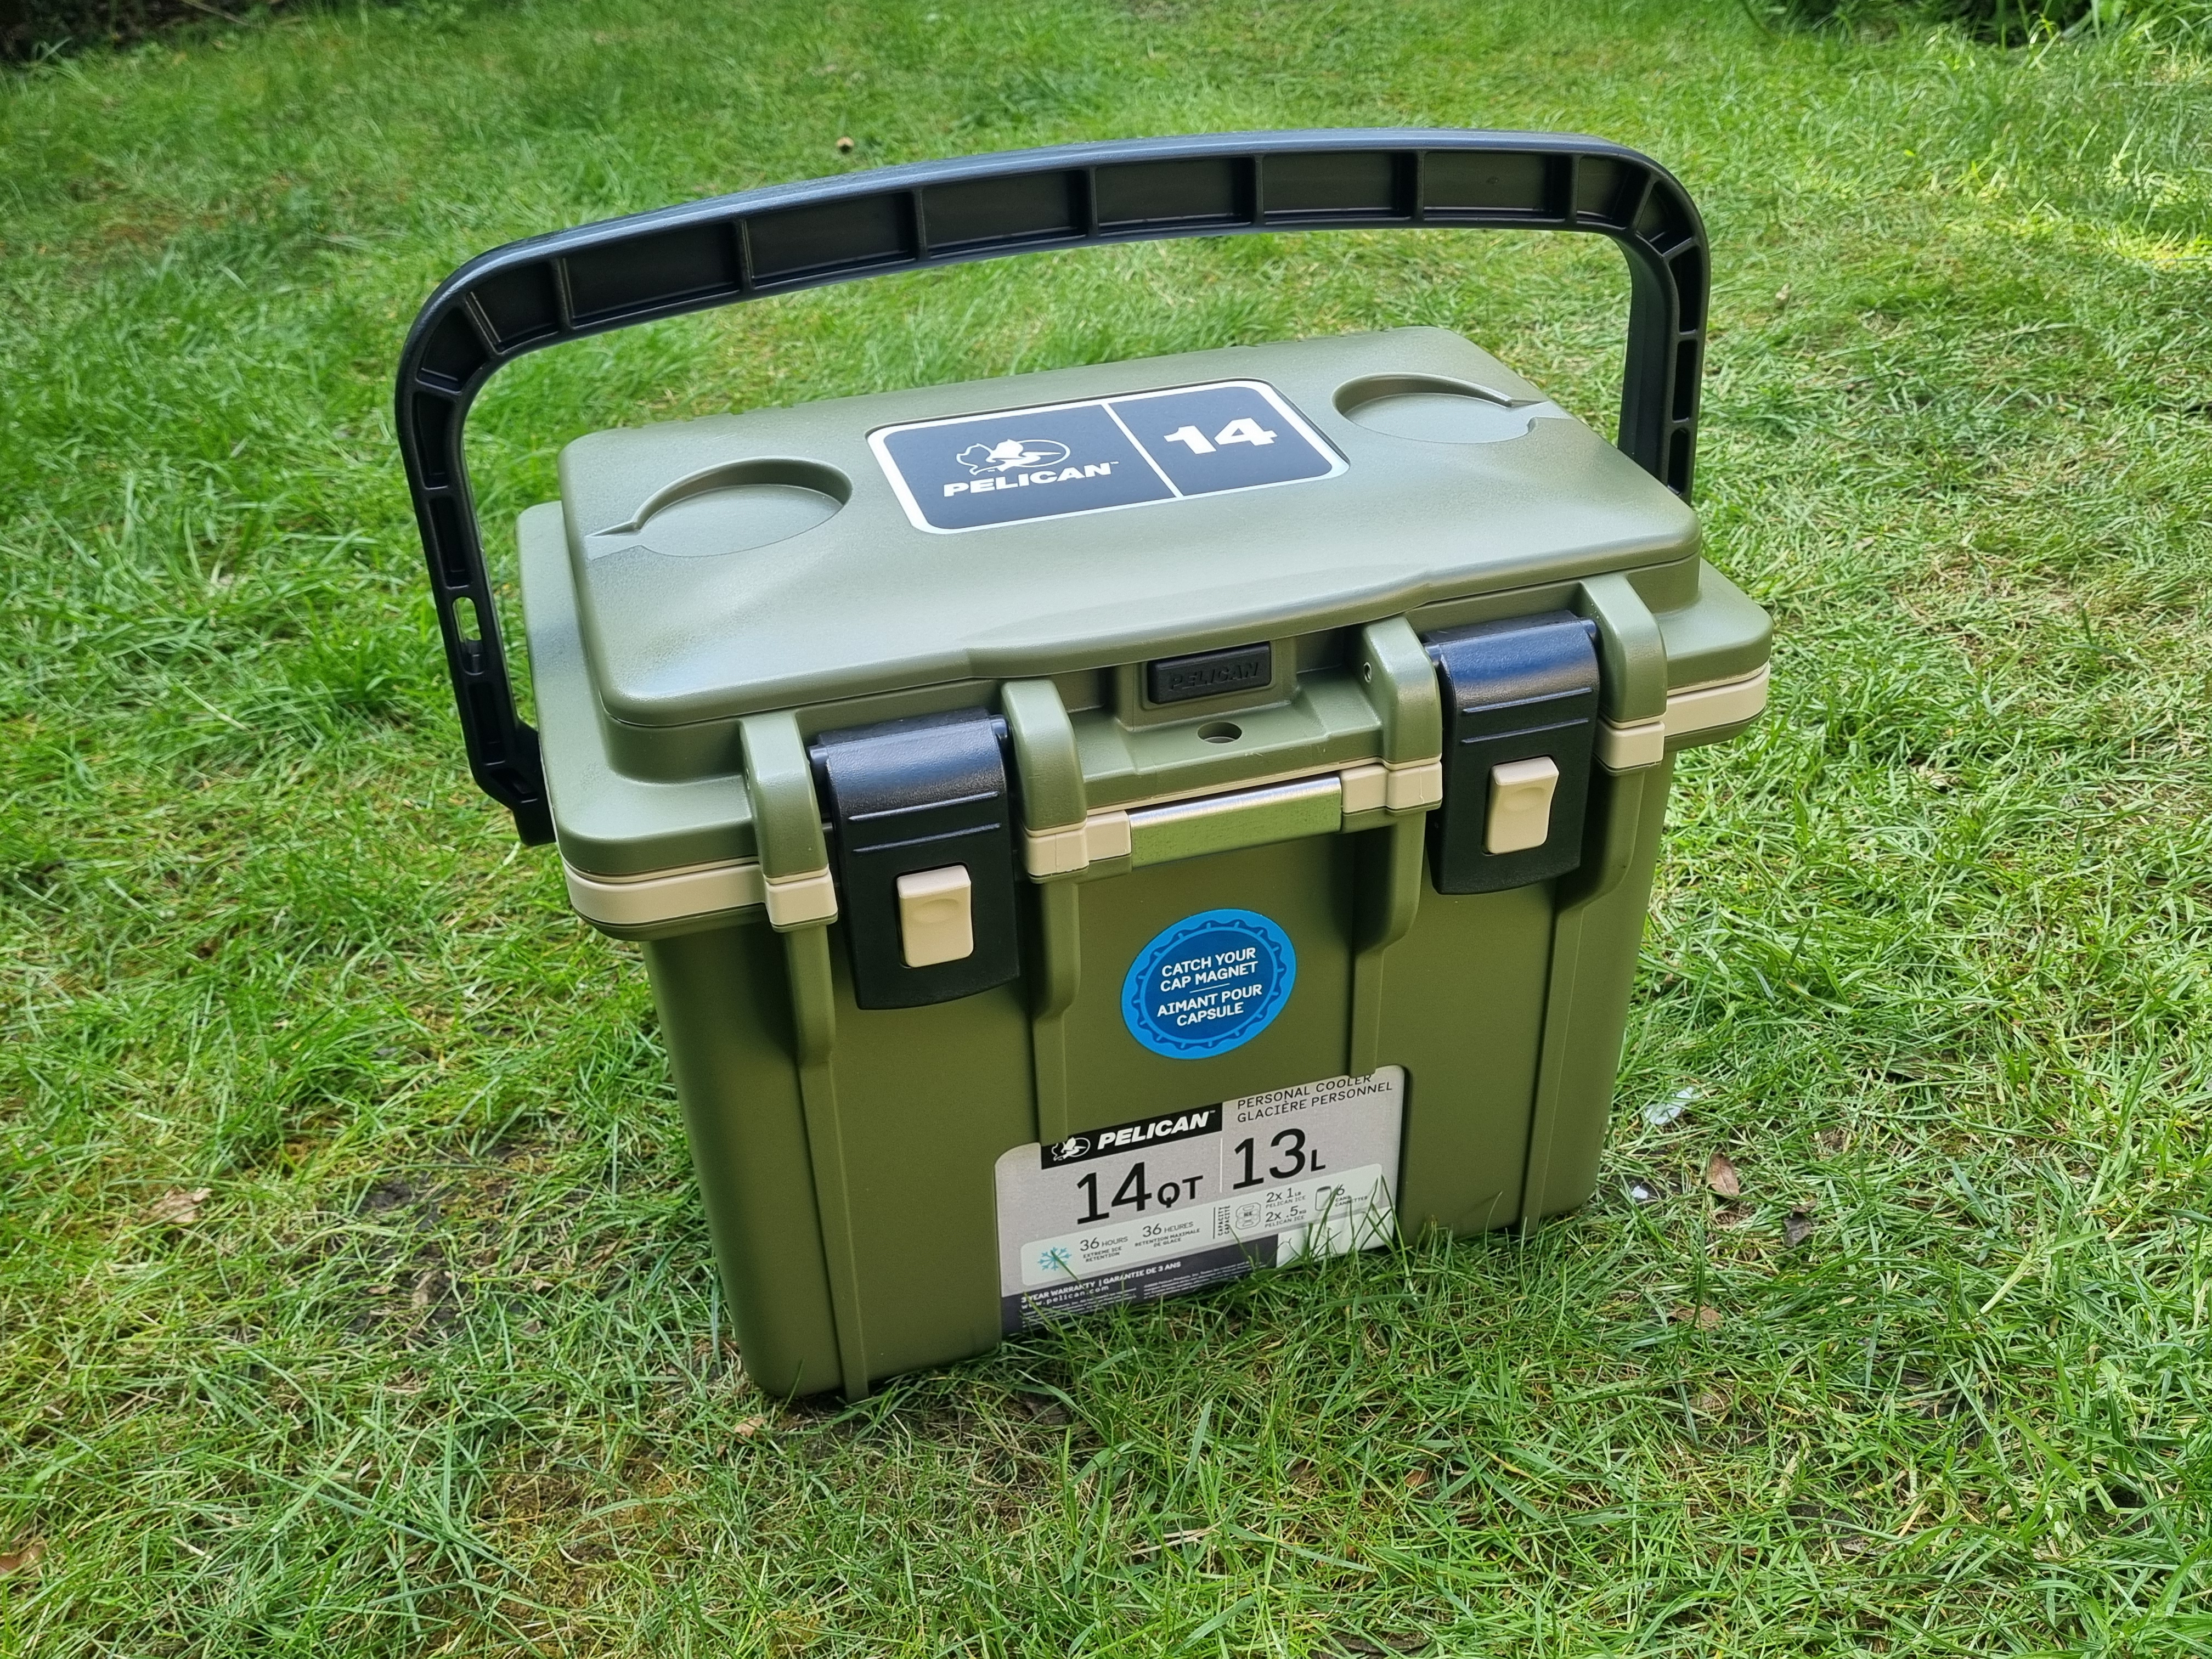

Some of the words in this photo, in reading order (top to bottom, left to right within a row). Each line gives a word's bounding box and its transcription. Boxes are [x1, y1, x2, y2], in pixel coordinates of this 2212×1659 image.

[1163, 417, 1278, 455] 14
[943, 462, 1111, 498] PELICAN
[1168, 661, 1259, 691] PELICAN
[1160, 975, 1191, 992] CAP
[1194, 961, 1259, 986] MAGNET
[1161, 956, 1212, 978] CATCH
[1215, 947, 1256, 966] YOUR
[1156, 993, 1218, 1017] AIMANT
[1221, 984, 1262, 1003] POUR
[1176, 1002, 1244, 1026] CAPSULE
[1237, 1086, 1310, 1110] PERSONAL
[1316, 1074, 1372, 1093] COOLER
[1237, 1098, 1307, 1122] GLACIÈRE
[1311, 1081, 1393, 1107] PERSONNEL
[1097, 1110, 1210, 1150] PELICAN
[1265, 1198, 1293, 1209] PELICAN
[1336, 1184, 1345, 1196] 6
[1142, 1223, 1162, 1238] 36
[1164, 1221, 1194, 1233] HEURES
[1265, 1218, 1293, 1228] PELICAN
[1079, 1237, 1100, 1252] 36
[1102, 1235, 1128, 1247] HOURS
[1146, 1266, 1158, 1276] DE
[1164, 1261, 1182, 1271] ANS
[1021, 1285, 1109, 1310] ww.pelican.com
